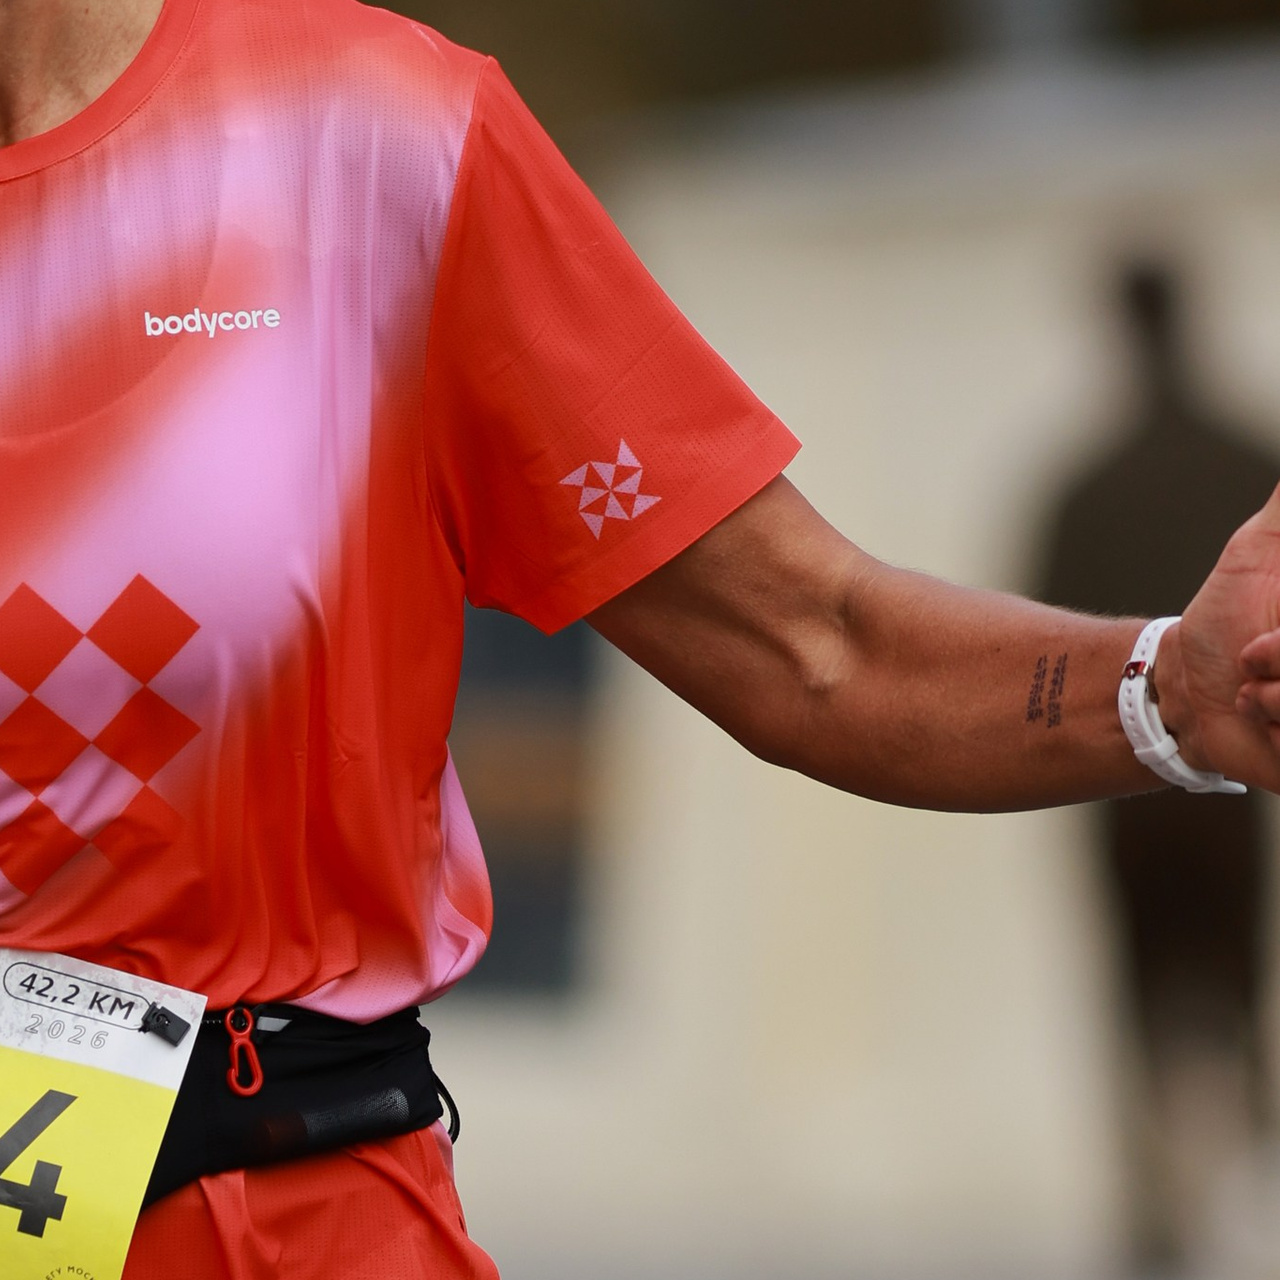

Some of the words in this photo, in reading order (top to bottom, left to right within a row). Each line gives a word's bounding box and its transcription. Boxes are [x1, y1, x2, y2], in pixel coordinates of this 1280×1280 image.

[144, 307, 281, 338] bodycore
[19, 973, 80, 1006] 42,2
[24, 1013, 110, 1050] 2026
